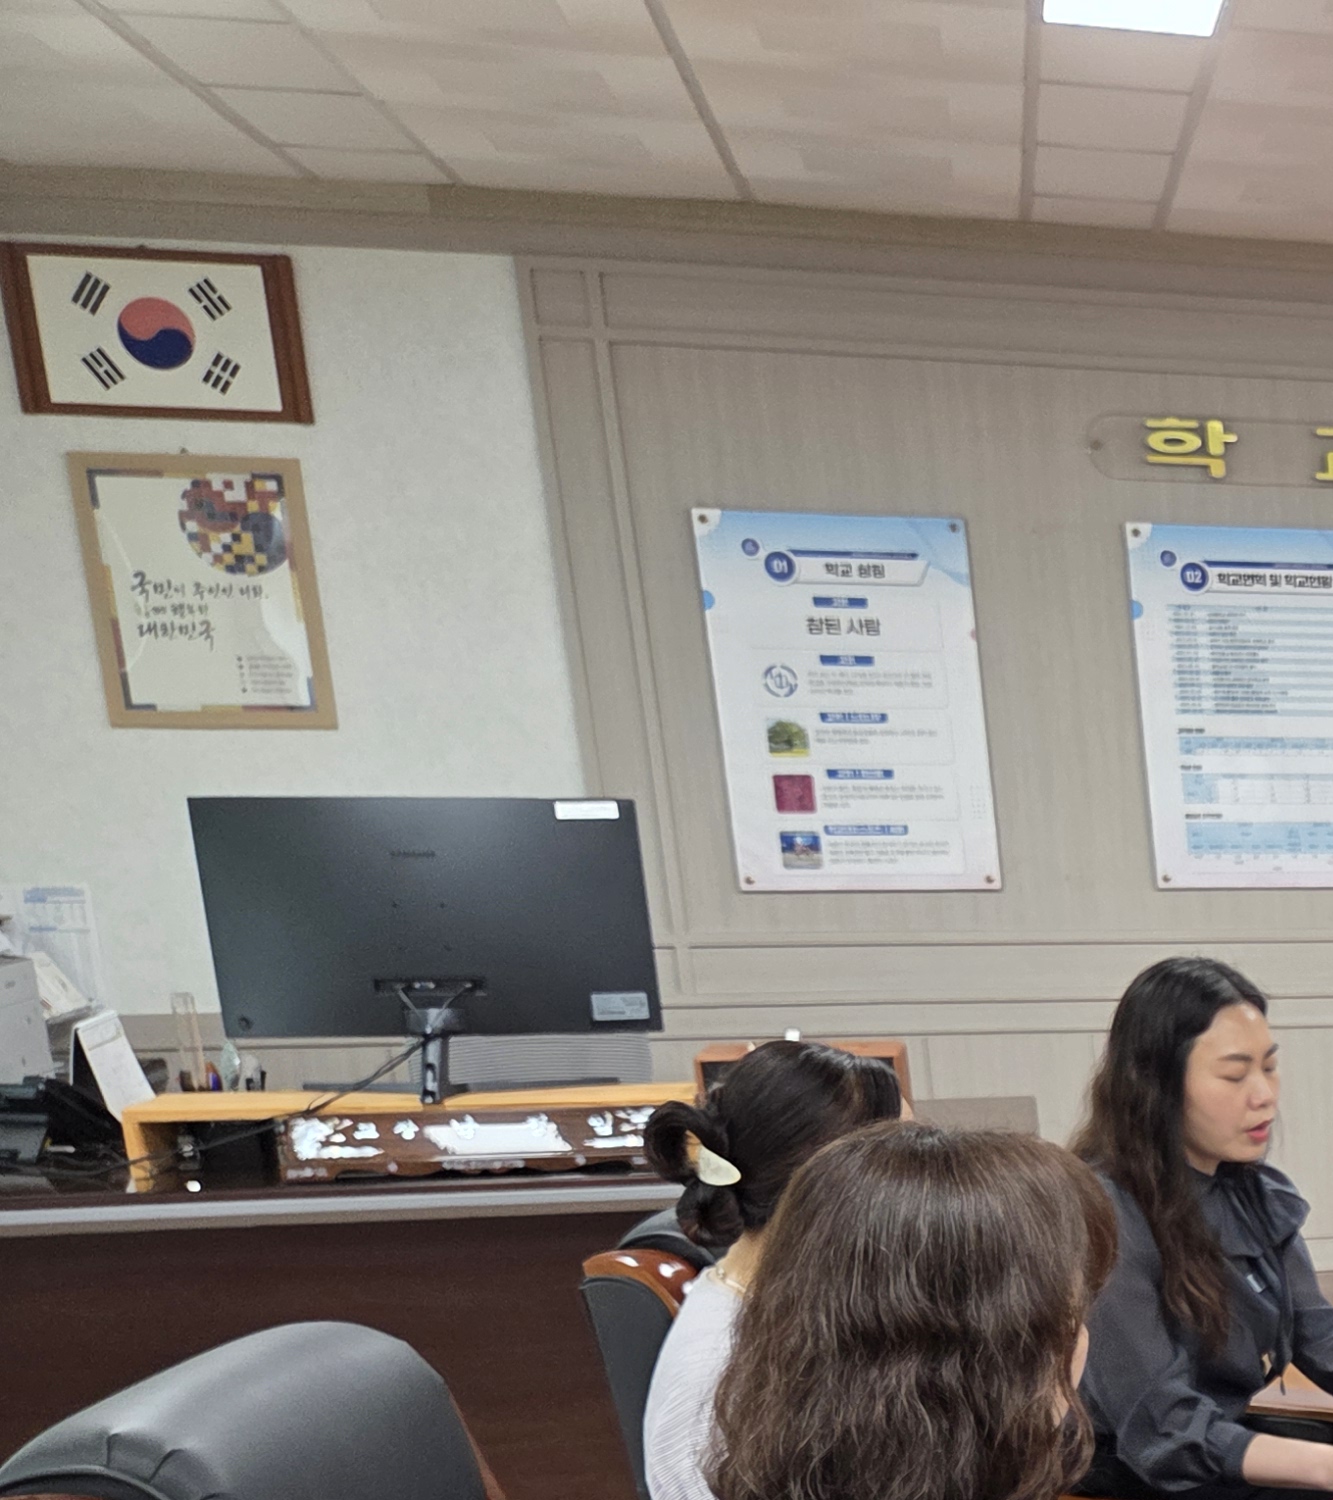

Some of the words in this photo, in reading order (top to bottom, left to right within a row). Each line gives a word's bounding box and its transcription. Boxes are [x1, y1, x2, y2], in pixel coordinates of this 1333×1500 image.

[823, 561, 853, 578] 학교
[1185, 572, 1202, 584] 02
[806, 616, 841, 635] 참된
[846, 617, 881, 636] 사람
[136, 620, 216, 652] 대한민국
